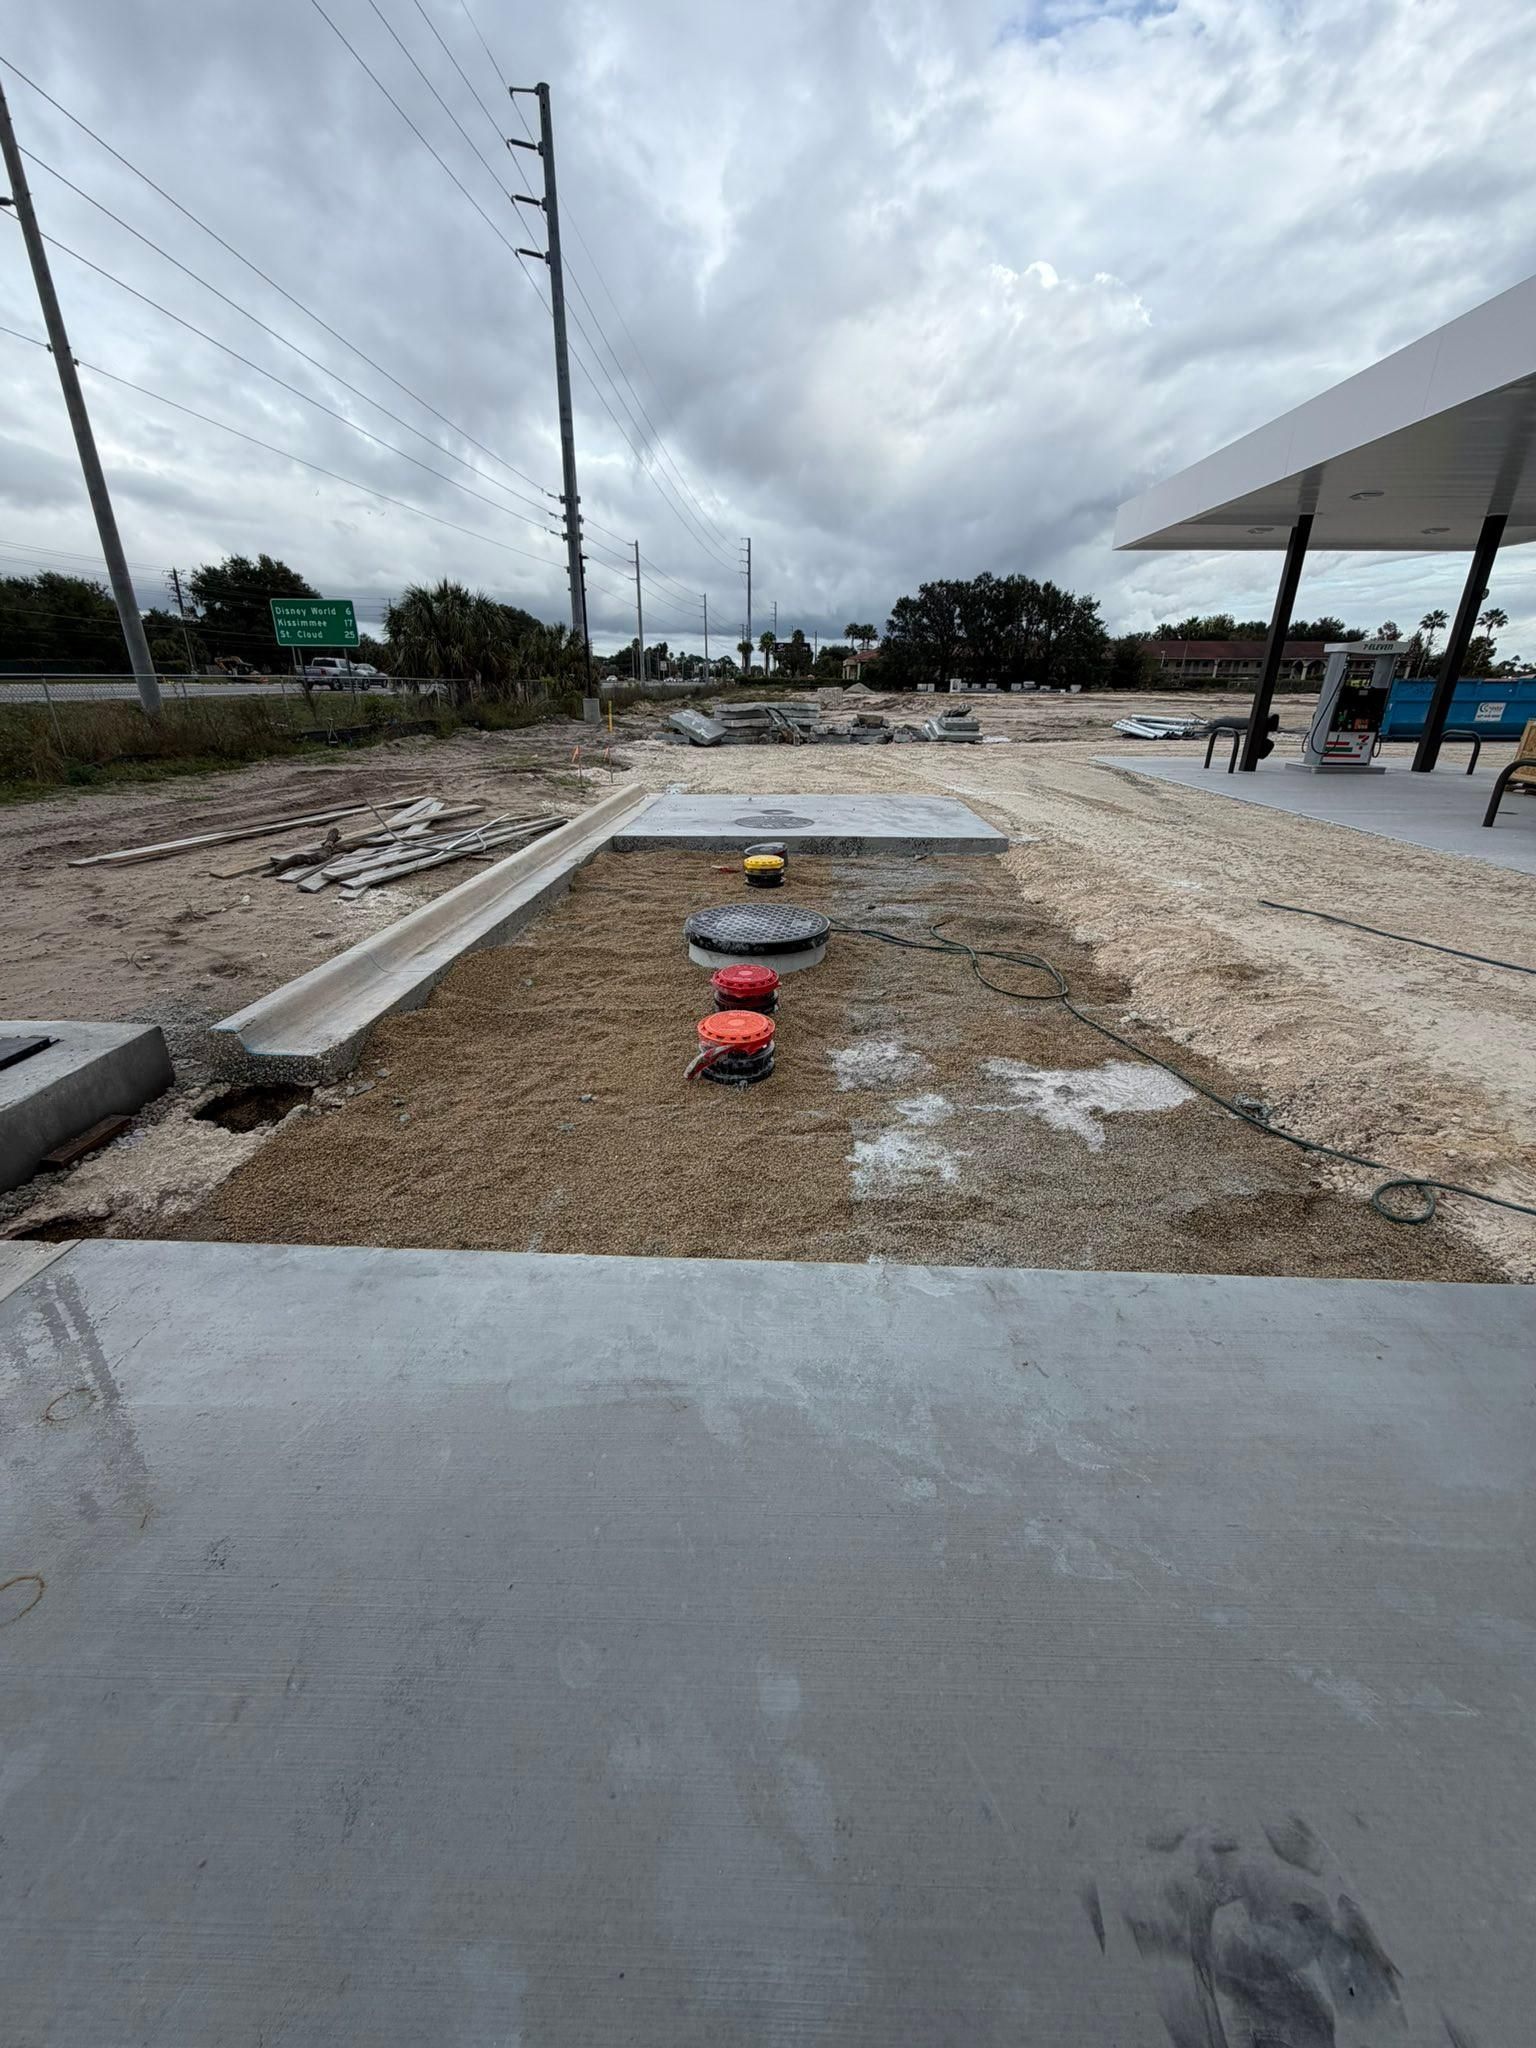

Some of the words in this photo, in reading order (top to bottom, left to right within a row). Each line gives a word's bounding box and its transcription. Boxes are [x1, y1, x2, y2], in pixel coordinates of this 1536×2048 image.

[275, 606, 307, 617] Disney
[311, 607, 337, 616] World
[345, 607, 352, 616] 6
[277, 618, 328, 627] Kissimmee
[344, 619, 353, 628] 17
[280, 630, 293, 639] St.
[297, 630, 324, 639] Cloud
[344, 630, 356, 639] 25
